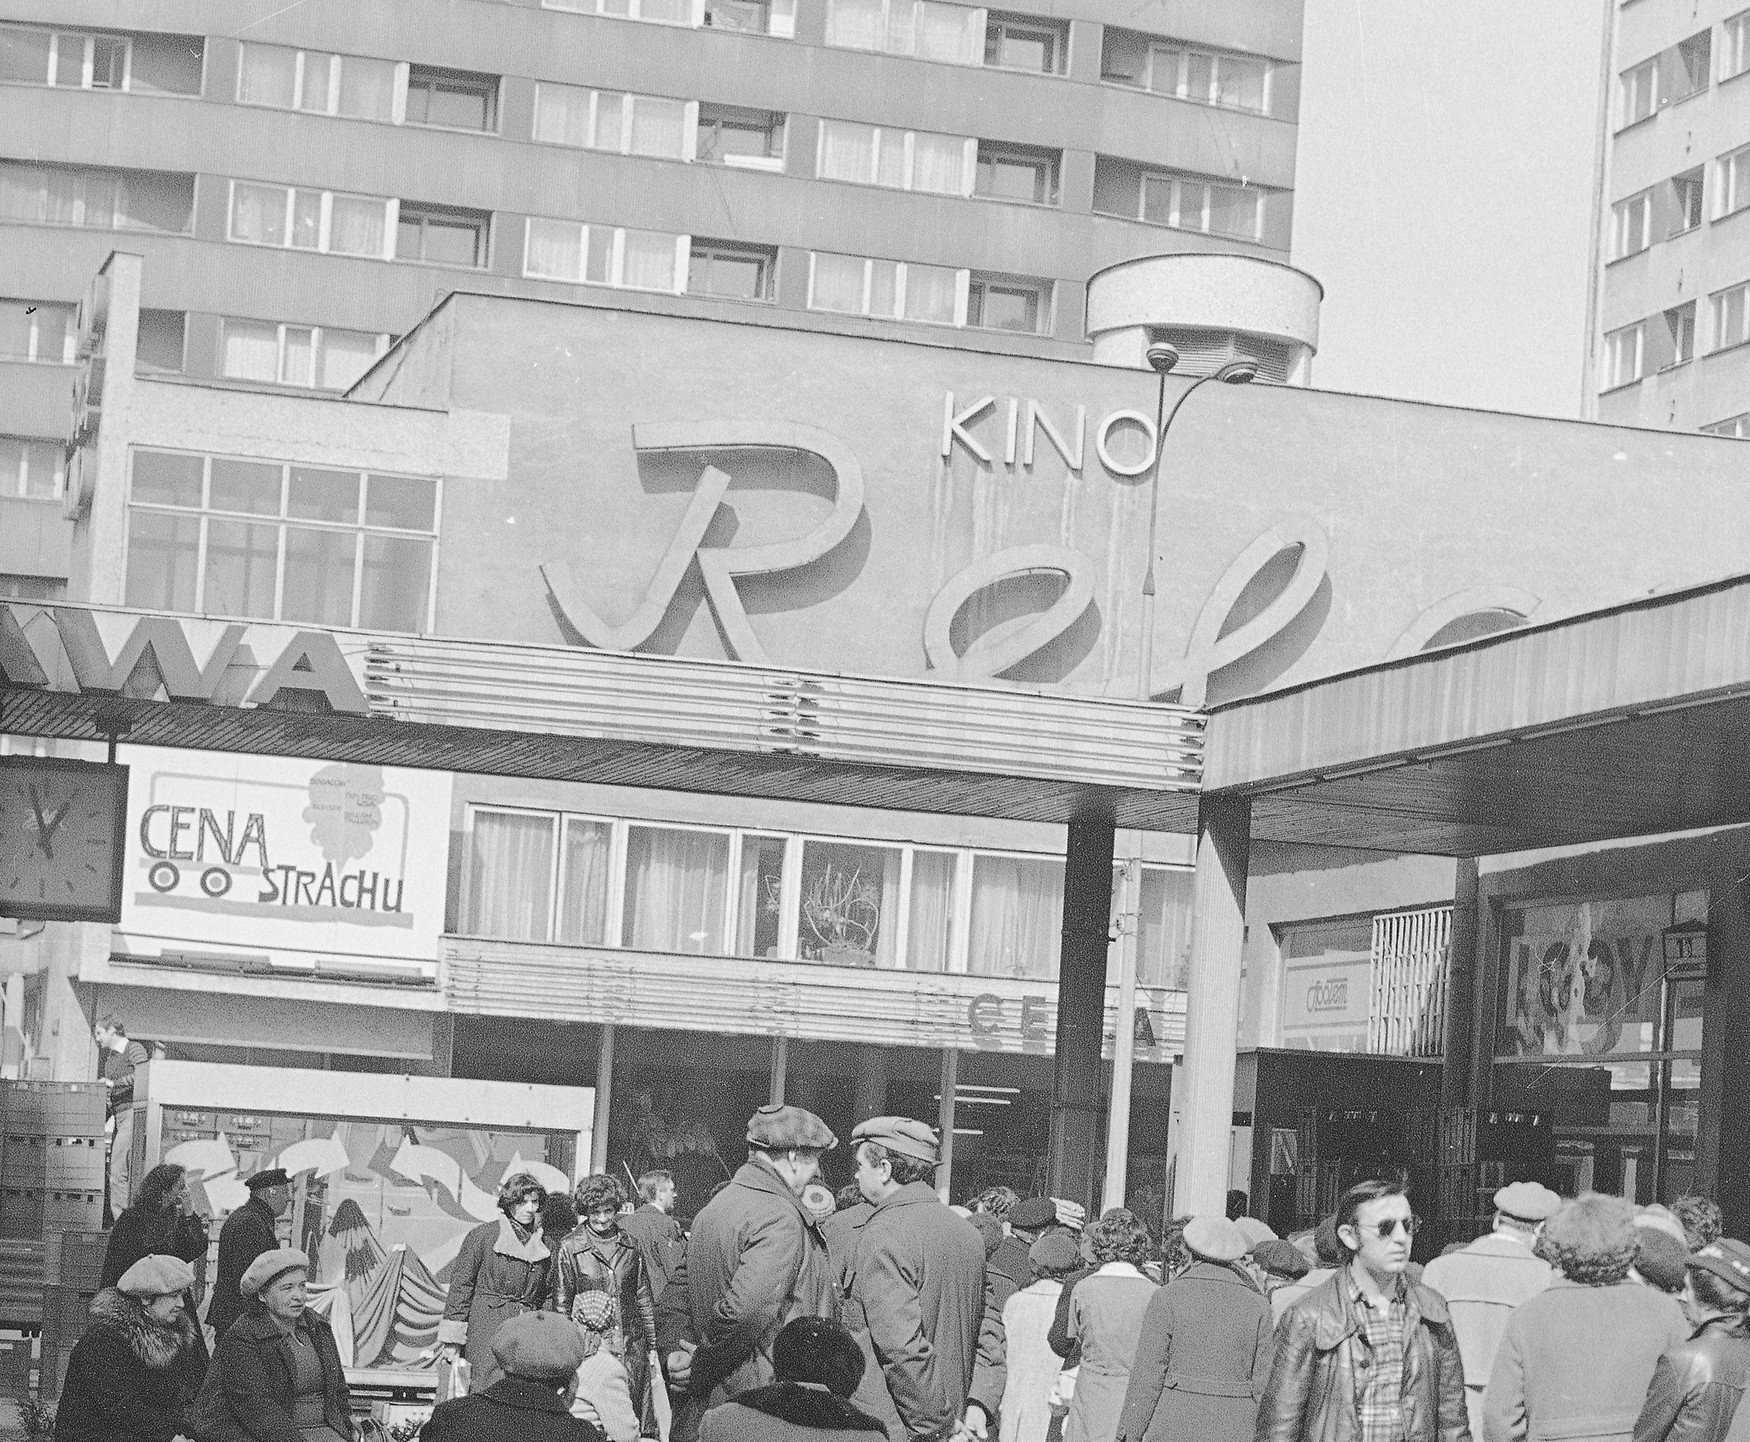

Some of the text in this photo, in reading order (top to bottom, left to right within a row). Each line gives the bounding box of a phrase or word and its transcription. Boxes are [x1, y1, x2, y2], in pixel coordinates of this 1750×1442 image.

[940, 390, 1162, 477] KINO
[0, 602, 374, 717] WA
[139, 803, 270, 869] CENA
[257, 861, 404, 914] STRACHU
